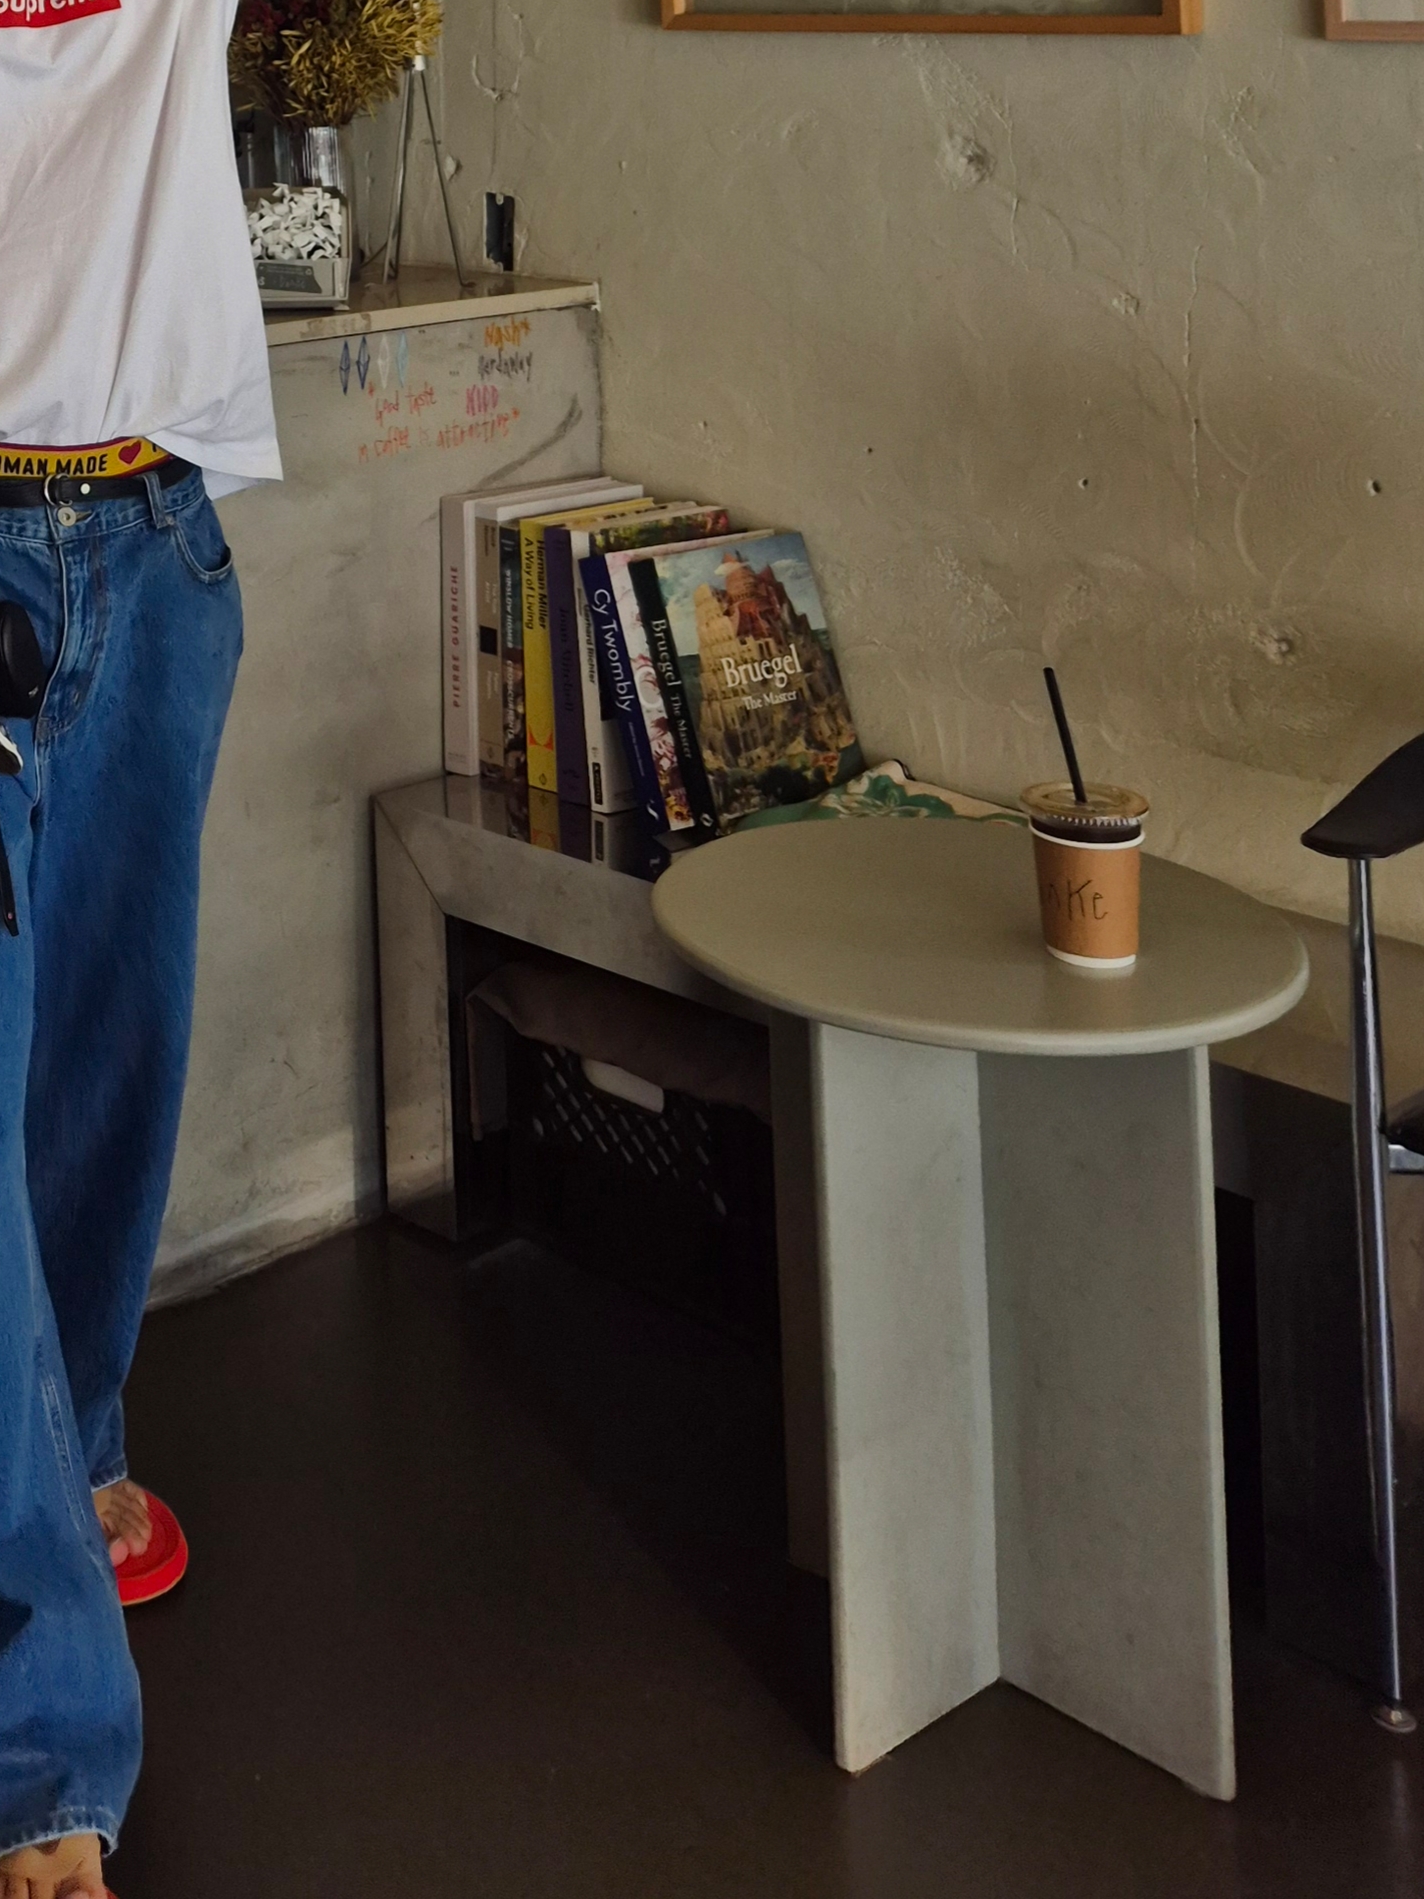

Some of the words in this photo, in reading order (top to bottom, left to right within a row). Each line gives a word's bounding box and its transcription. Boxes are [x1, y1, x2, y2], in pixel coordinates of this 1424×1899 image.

[54, 453, 108, 476] MADE
[524, 537, 534, 547] A
[524, 549, 535, 576] Way
[536, 540, 547, 590] Herman
[505, 569, 514, 613] WINSLOW
[525, 577, 536, 592] of
[591, 589, 611, 616] Cy
[449, 564, 461, 647] GUARICHE
[525, 593, 536, 631] Living
[537, 592, 548, 630] Miller
[505, 614, 514, 649] HOMER
[583, 604, 596, 646] Gerhard
[585, 646, 597, 685] Richter
[599, 619, 636, 713] Twombly
[650, 618, 682, 687] Bruegel
[720, 643, 803, 688] Bruegel
[451, 653, 461, 708] PIERRE
[668, 692, 686, 718] The
[741, 696, 764, 711] The
[762, 690, 798, 706] Master
[674, 719, 693, 760] Master
